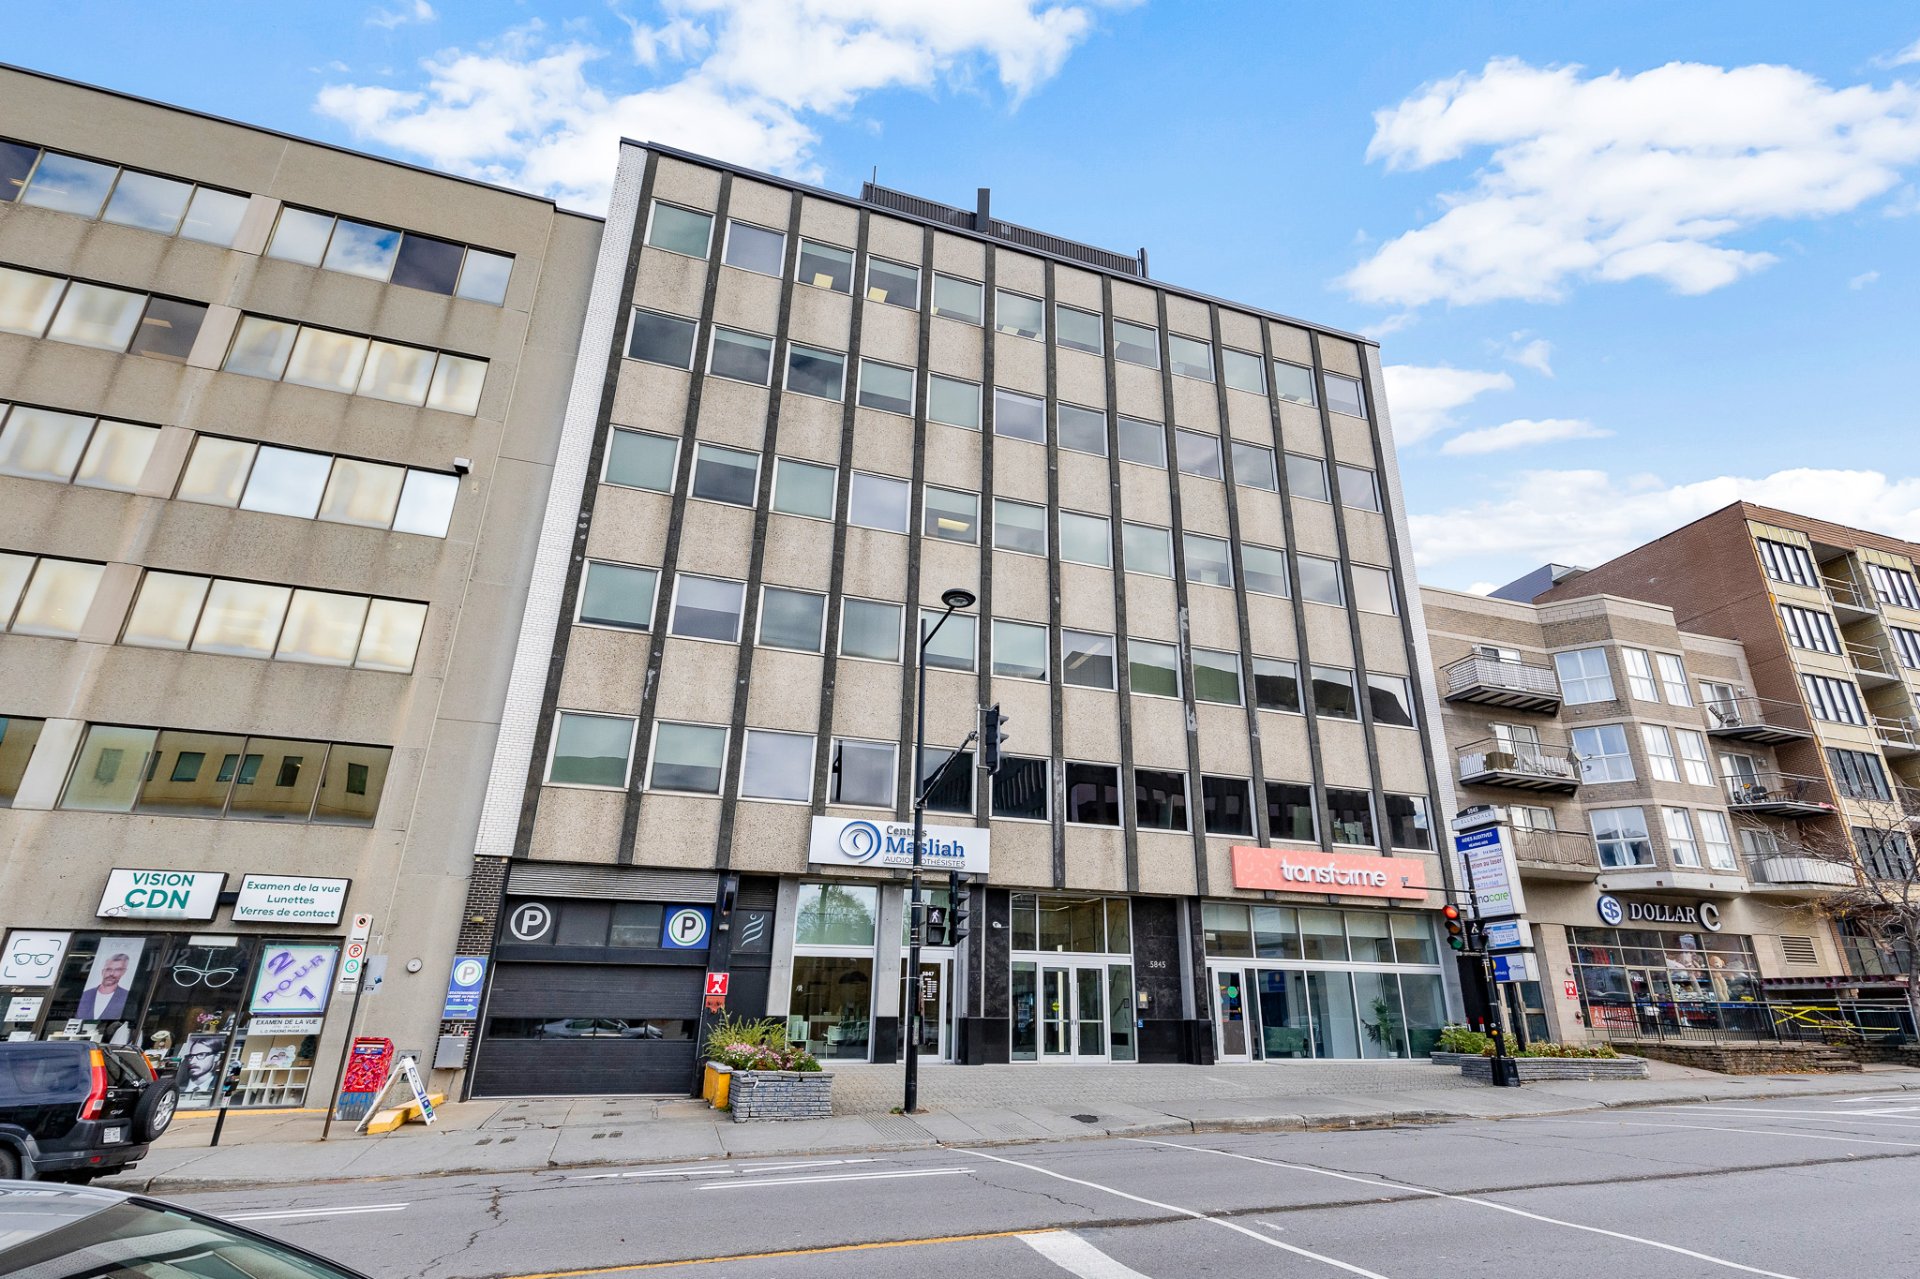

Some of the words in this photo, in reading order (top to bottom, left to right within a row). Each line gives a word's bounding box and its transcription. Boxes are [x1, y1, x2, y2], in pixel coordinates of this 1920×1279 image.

[886, 825, 927, 837] Centrs
[886, 836, 965, 858] Masliah
[133, 873, 195, 887] VISION
[1280, 857, 1387, 887] transforme
[246, 881, 290, 891] Examen
[292, 883, 307, 891] de
[308, 884, 319, 892] la
[124, 889, 190, 910] CDN
[267, 895, 315, 904] Lunettes
[240, 906, 274, 916] Verres
[276, 908, 290, 916] de
[292, 910, 335, 918] contact
[1630, 903, 1697, 923] DOLLAR
[1700, 902, 1721, 932] C
[681, 916, 696, 938] P
[268, 952, 296, 976] 2
[299, 986, 315, 1000] 1
[462, 966, 475, 980] P
